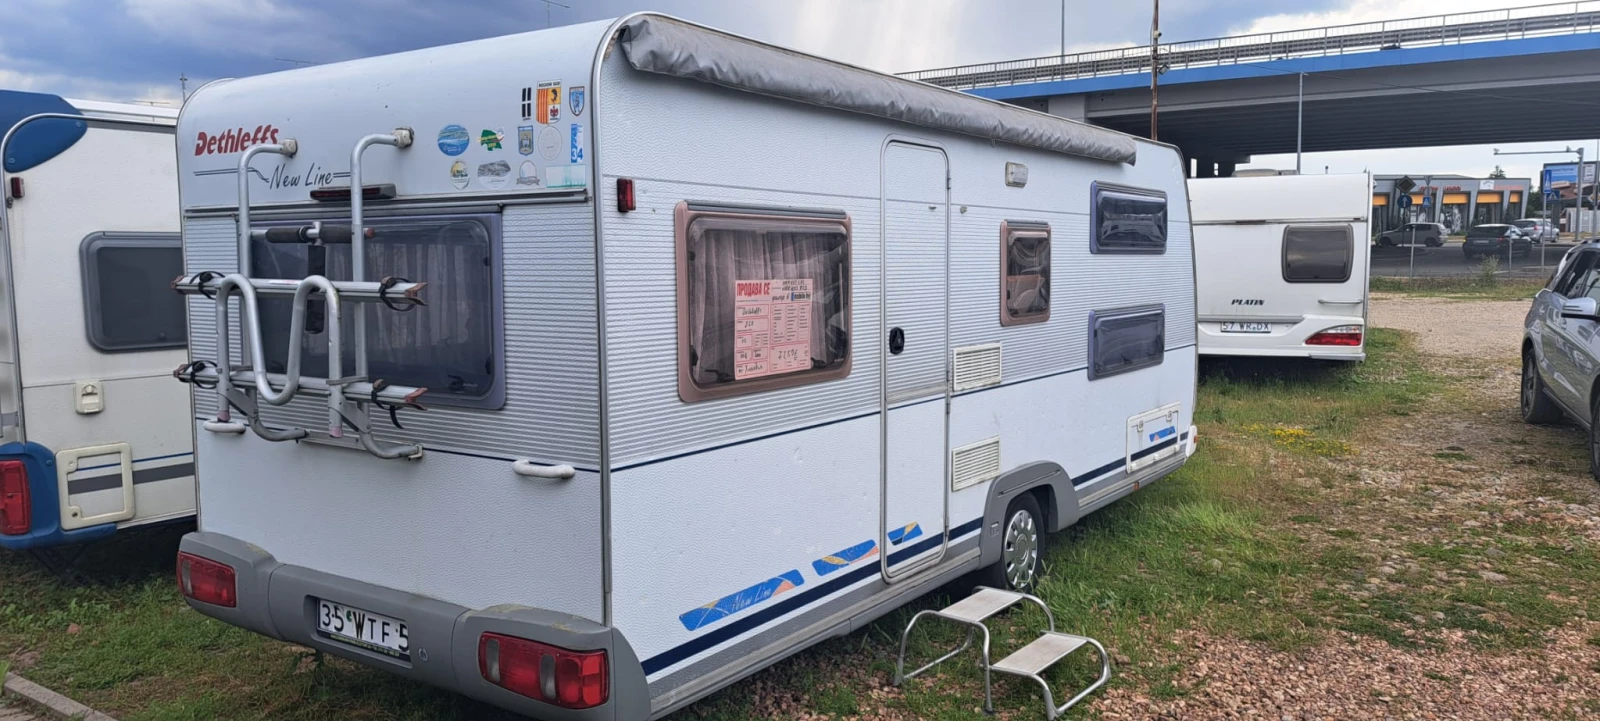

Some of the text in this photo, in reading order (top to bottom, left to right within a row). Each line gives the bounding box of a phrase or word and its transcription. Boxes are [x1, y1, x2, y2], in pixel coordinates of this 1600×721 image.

[195, 125, 279, 156] Dethleffs
[270, 162, 333, 189] New Line
[737, 282, 762, 297] ПРОДАВА
[763, 282, 770, 295] СЕ
[1222, 322, 1270, 331] 57 WR DX
[731, 592, 752, 612] New
[322, 604, 344, 632] 35
[352, 611, 390, 642] WTF
